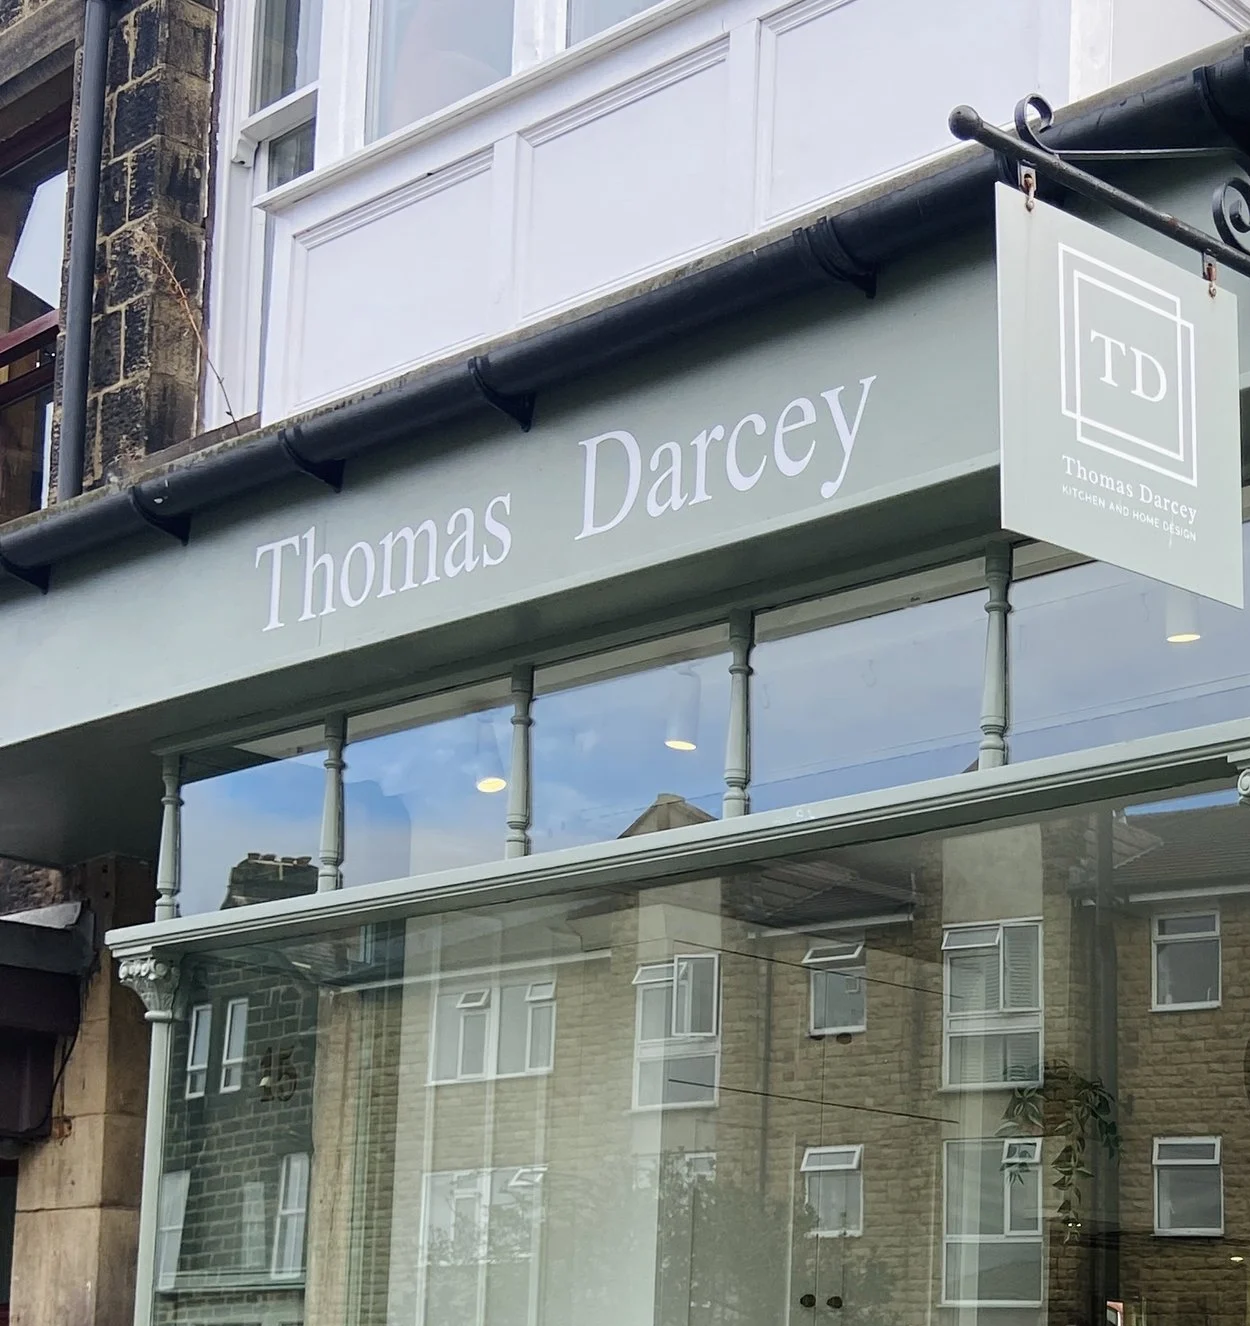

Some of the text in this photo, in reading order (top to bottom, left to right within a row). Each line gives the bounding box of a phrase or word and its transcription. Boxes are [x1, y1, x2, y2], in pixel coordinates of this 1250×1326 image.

[1090, 329, 1168, 403] TD
[255, 375, 877, 632] Thomas Darcey
[1062, 454, 1197, 525] Thomas Darcey
[1062, 485, 1197, 542] KITCHEN AND HOME DESIGN
